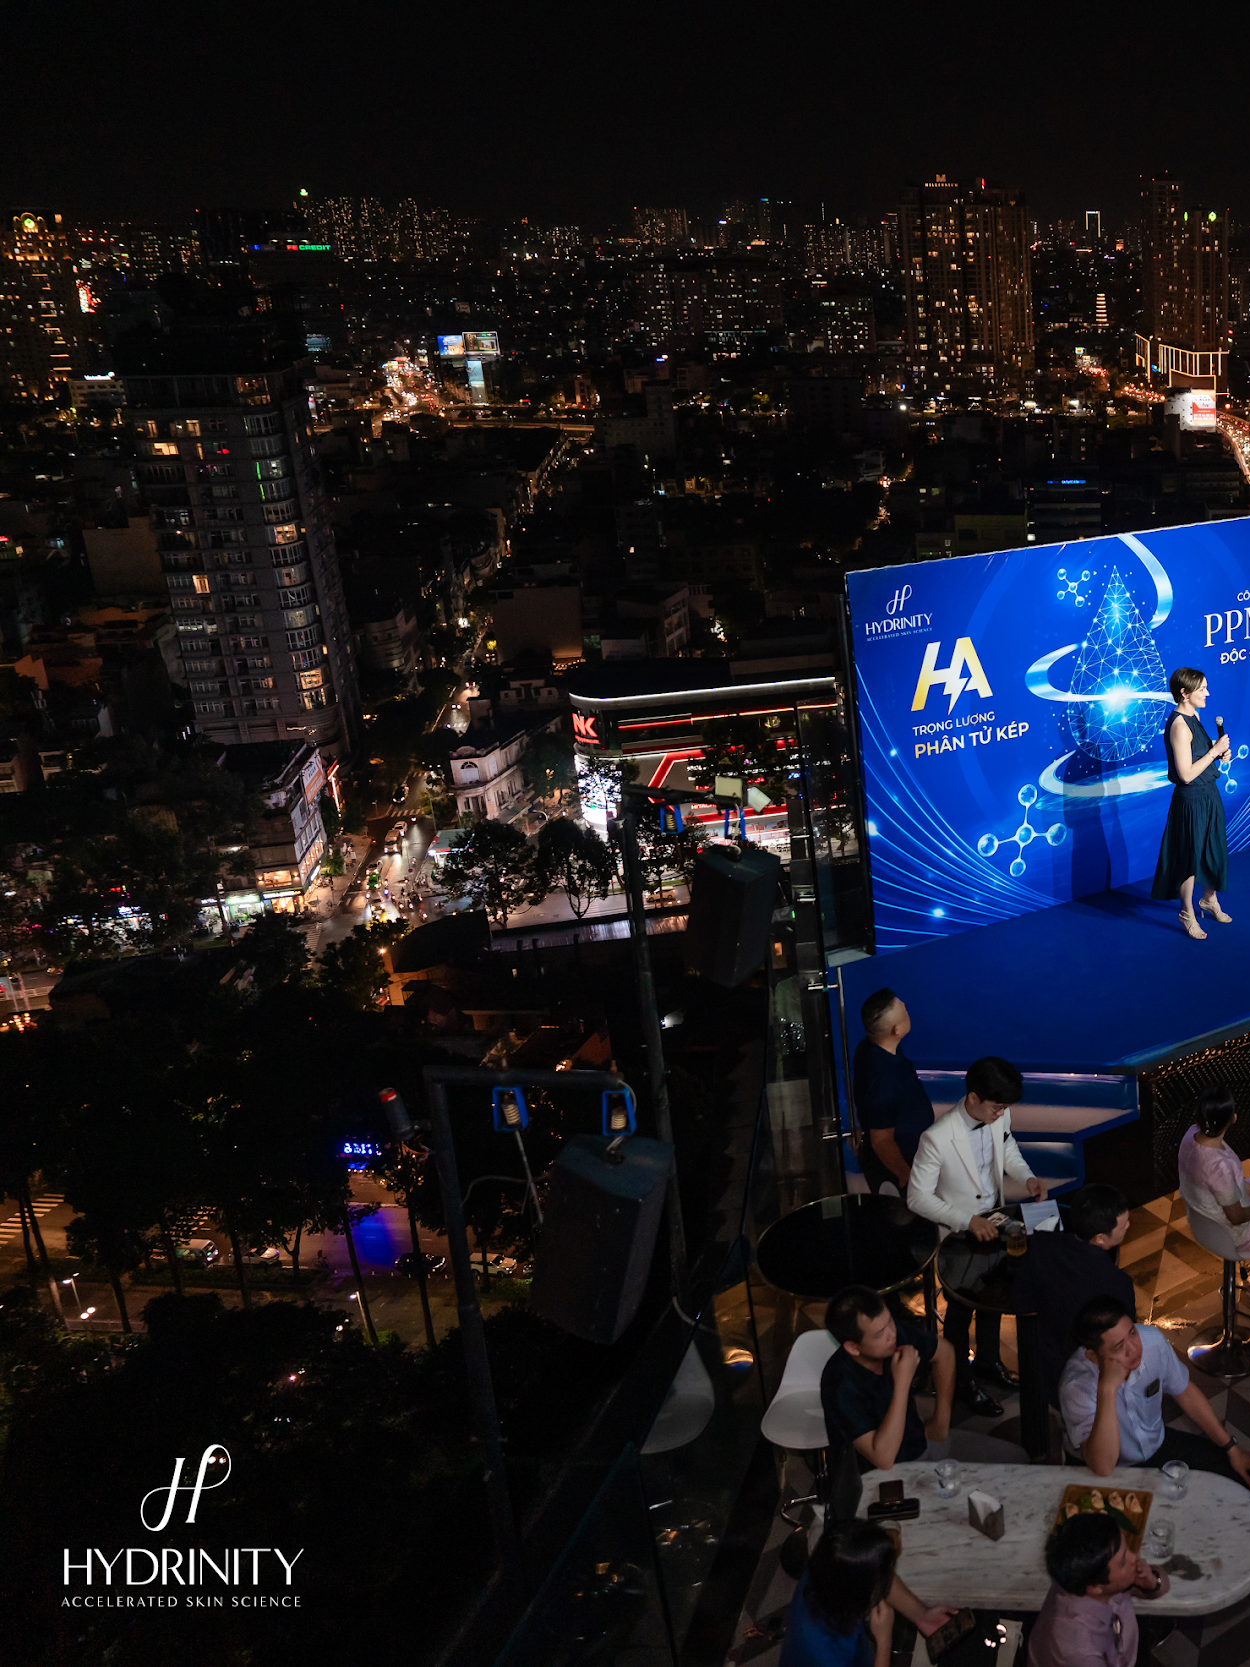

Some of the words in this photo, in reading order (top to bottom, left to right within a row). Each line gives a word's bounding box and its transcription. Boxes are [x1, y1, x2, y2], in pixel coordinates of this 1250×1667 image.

[865, 612, 933, 635] HYDRINITY
[1220, 648, 1247, 665] ĐỘC
[911, 636, 994, 716] HA
[571, 712, 598, 737] NK
[912, 719, 953, 737] TRỌNG
[956, 711, 996, 727] LƯỢNG
[914, 734, 965, 759] PHÂN
[968, 725, 993, 747] TỬ
[996, 720, 1030, 741] KÉP
